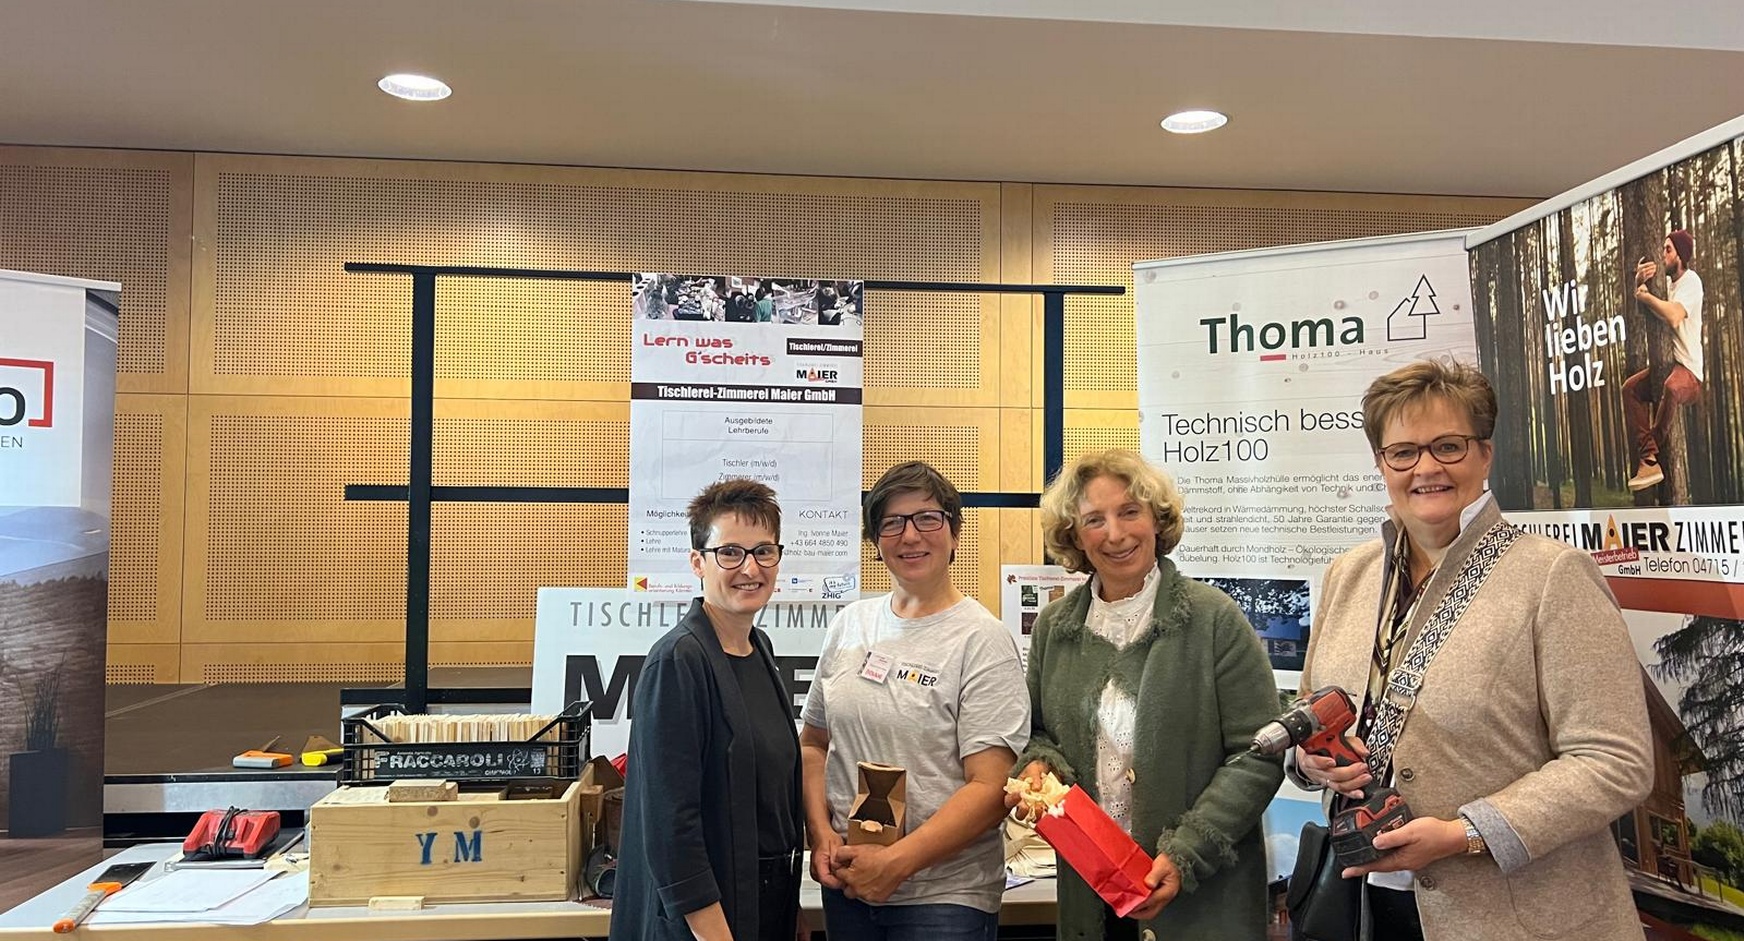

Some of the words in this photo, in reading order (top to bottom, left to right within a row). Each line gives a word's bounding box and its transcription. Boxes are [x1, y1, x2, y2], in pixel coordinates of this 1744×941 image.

[1542, 279, 1588, 321] Wir
[1199, 313, 1365, 354] Thoma
[1545, 314, 1627, 358] lieben
[643, 333, 689, 347] Lern
[695, 337, 734, 348] was
[788, 342, 858, 353] Tischlerei/Zimmerei
[1291, 350, 1341, 361] Holz100
[1359, 348, 1389, 356] Haus
[796, 367, 838, 381] MAIER
[1549, 352, 1605, 395] Holz
[657, 385, 768, 401] Tischlerei-Zimmerei
[770, 388, 802, 401] Maier
[804, 389, 836, 402] GmbH
[724, 416, 773, 425] Ausgebildete
[1161, 409, 1290, 436] Technisch
[728, 426, 769, 435] Lehrberufe
[1162, 438, 1269, 464] Holz100
[722, 458, 749, 468] Tischler
[1177, 476, 1191, 485] Die
[1195, 475, 1223, 485] Thoma
[1226, 474, 1290, 484] Massivholzhülle
[1293, 473, 1339, 484] ermöglicht
[1342, 473, 1360, 482] das
[1227, 485, 1248, 494] ohne
[1250, 484, 1299, 495] Abhängigkeit
[1302, 485, 1318, 493] von
[1321, 484, 1354, 493] Technik
[1356, 483, 1374, 492] und
[799, 509, 849, 520] KONTAKT
[1225, 505, 1231, 513] in
[1308, 504, 1348, 514] höchster
[1196, 514, 1213, 523] und
[1273, 514, 1285, 523] 50
[1288, 514, 1313, 523] Jahre
[1315, 514, 1354, 523] Garantie
[1356, 515, 1386, 525] gegen
[1210, 525, 1238, 533] setzen
[1240, 525, 1260, 533] neue
[1262, 525, 1308, 534] technische
[1309, 524, 1378, 536] Bestleistungen.
[1581, 514, 1670, 551] MAIER
[1674, 521, 1744, 554] ZIMME
[790, 539, 803, 547] +43
[804, 539, 817, 547] 664
[819, 539, 835, 547] 4850
[836, 539, 849, 547] 490
[1179, 543, 1220, 553] Dauerhaft
[1221, 544, 1245, 553] durch
[1246, 544, 1287, 554] Mondholz
[1223, 554, 1257, 564] Holz100
[1258, 554, 1268, 563] ist
[1618, 564, 1641, 575] GmbH
[1643, 556, 1690, 573] Telefon
[1692, 557, 1730, 576] 04715
[896, 668, 938, 687] MAIER
[374, 750, 504, 770] FRACCAROLI
[415, 832, 439, 866] Y
[453, 830, 482, 863] M
